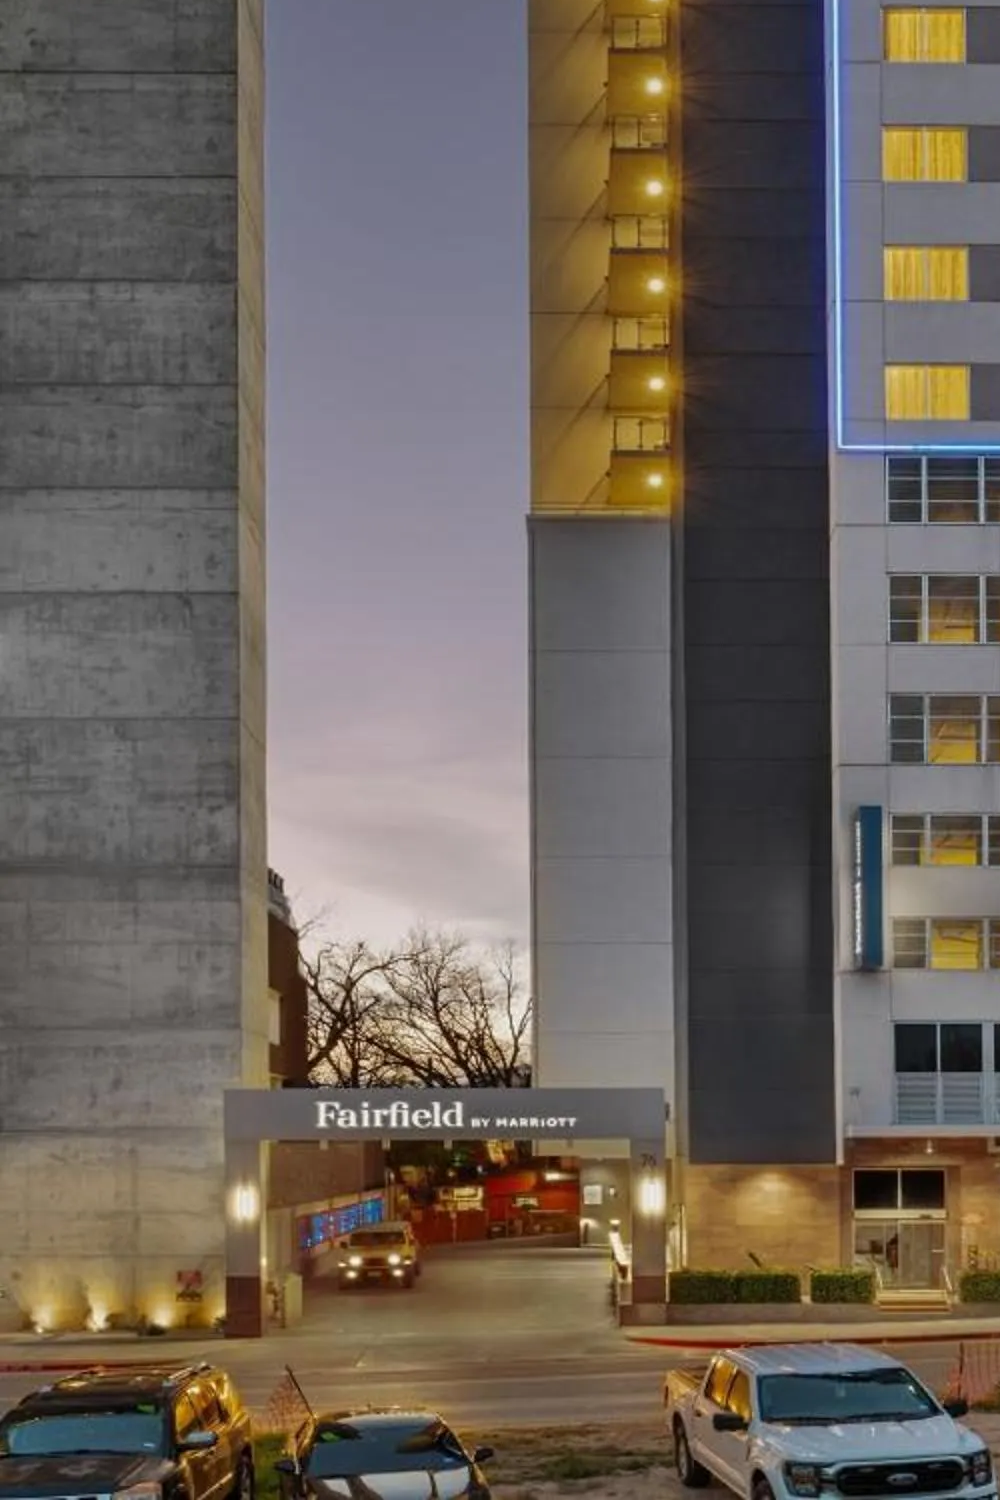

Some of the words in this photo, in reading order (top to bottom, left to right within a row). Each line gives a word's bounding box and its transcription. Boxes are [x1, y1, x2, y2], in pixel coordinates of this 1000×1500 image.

[315, 1100, 464, 1129] Fairfield
[471, 1117, 490, 1128] BY
[495, 1117, 577, 1128] MARRIOTT
